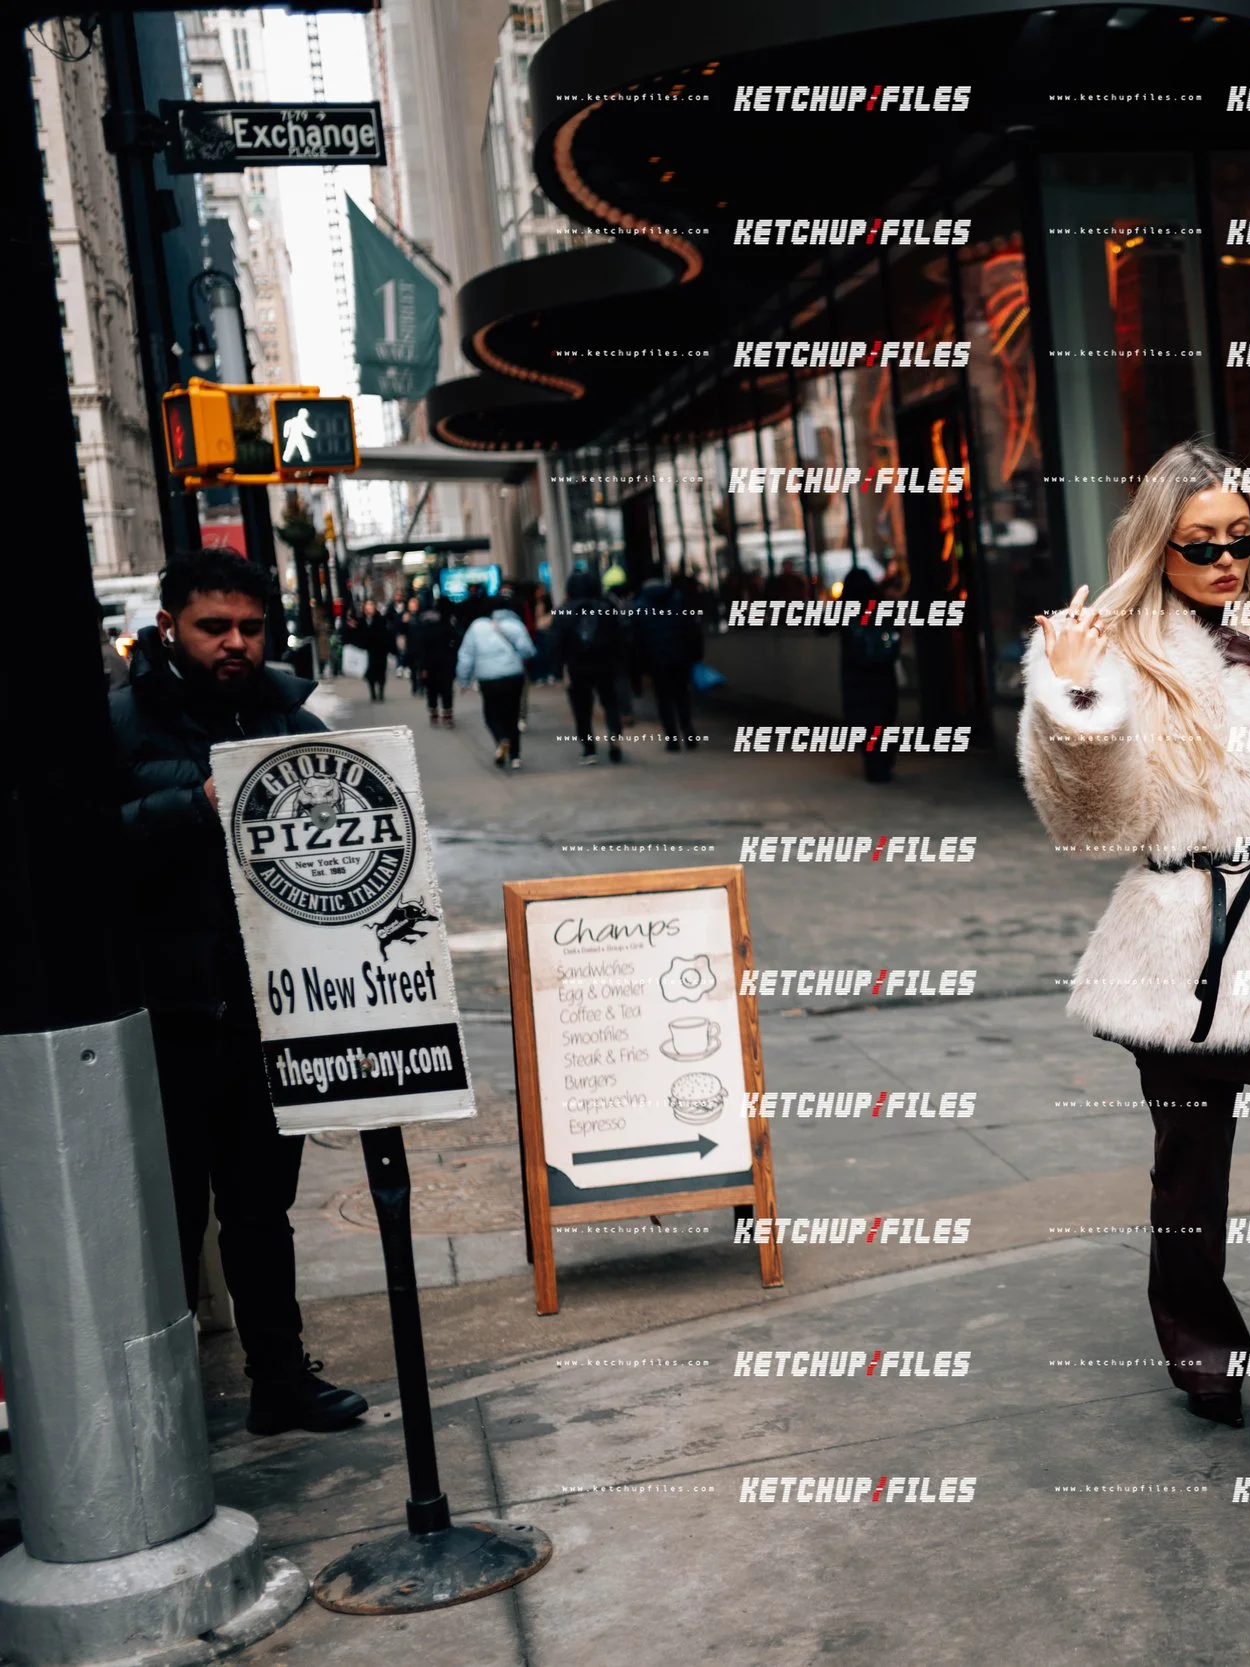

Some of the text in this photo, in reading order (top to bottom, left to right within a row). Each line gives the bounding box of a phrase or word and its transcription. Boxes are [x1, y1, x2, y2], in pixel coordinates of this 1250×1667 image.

[233, 118, 377, 156] Exchange
[288, 146, 328, 158] PLACE
[261, 754, 364, 795] GROTTO
[247, 814, 403, 855] PIZZA
[295, 856, 361, 869] New York City
[260, 853, 400, 912] AUTHENTIC ITALIAN
[553, 917, 681, 948] Champs
[557, 961, 636, 981] Sandwiches
[267, 961, 437, 1016] 69 New Street
[558, 986, 584, 1006] Egg
[587, 984, 598, 1000] &
[560, 1003, 642, 1025] Coffee & Tea
[562, 1025, 629, 1047] Smoothies
[564, 1046, 650, 1069] Steak & Fries
[564, 1073, 617, 1093] Burgers
[569, 1117, 627, 1137] Espresso
